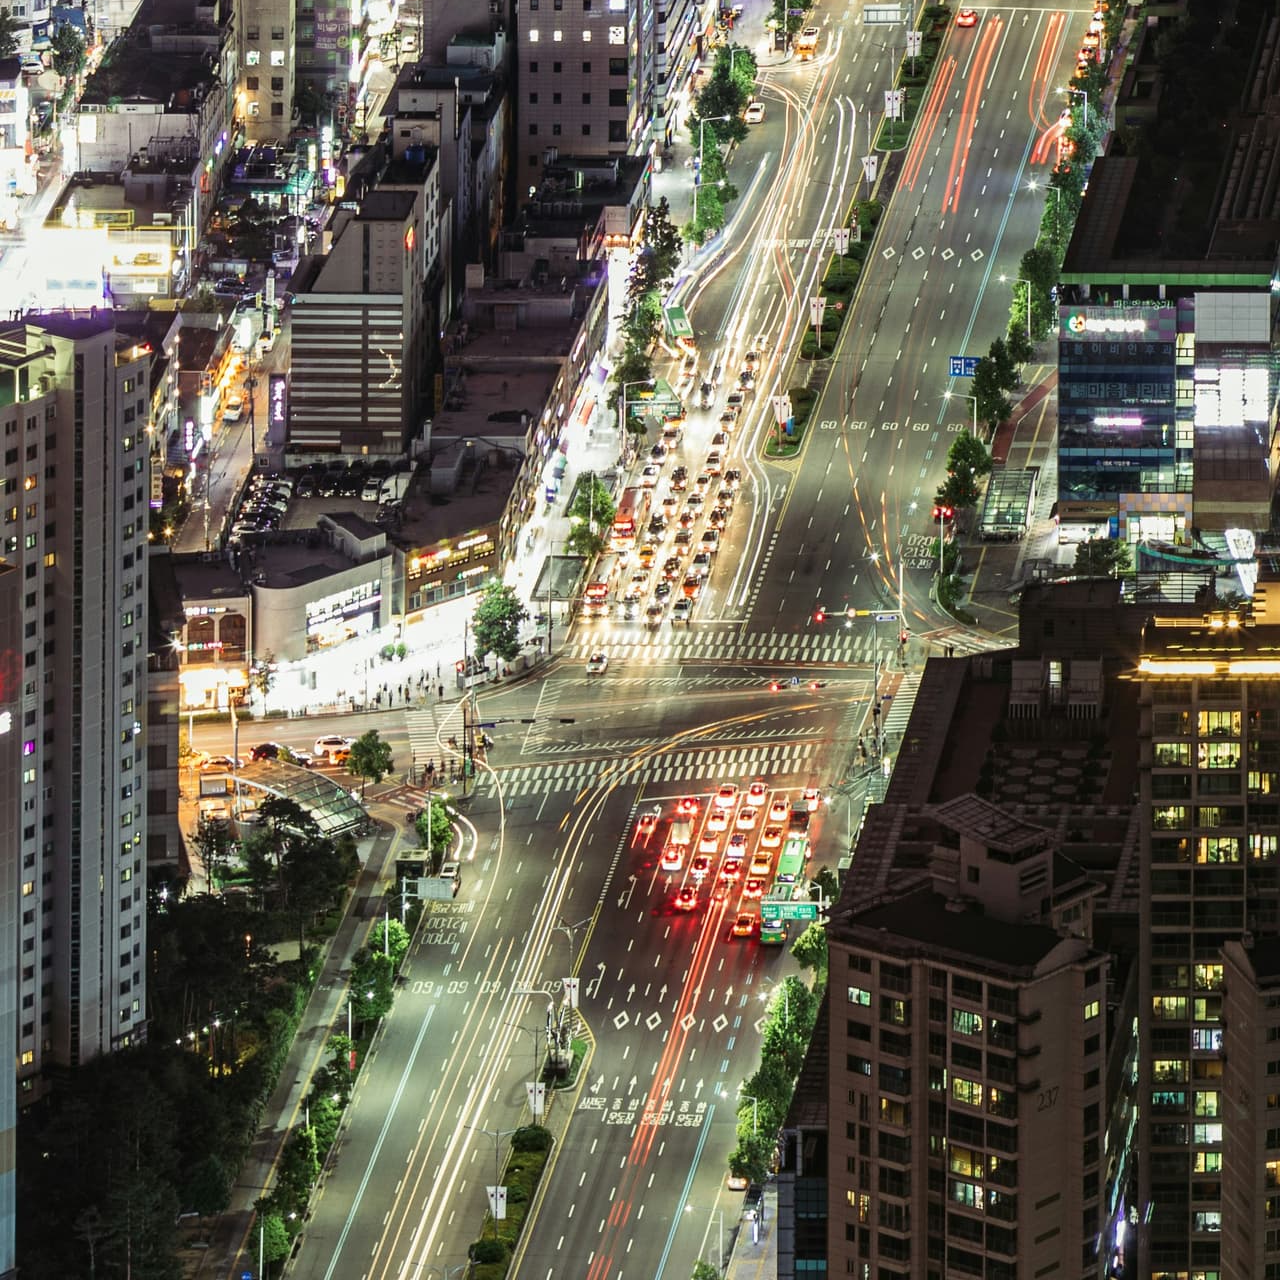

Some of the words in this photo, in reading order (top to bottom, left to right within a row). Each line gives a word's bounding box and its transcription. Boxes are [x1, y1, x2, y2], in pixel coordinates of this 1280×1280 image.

[819, 420, 838, 431] 60
[849, 421, 868, 431] 60
[881, 422, 899, 431] 60
[912, 422, 930, 432] 60
[946, 423, 964, 433] 60
[1037, 1085, 1060, 1112] 237
